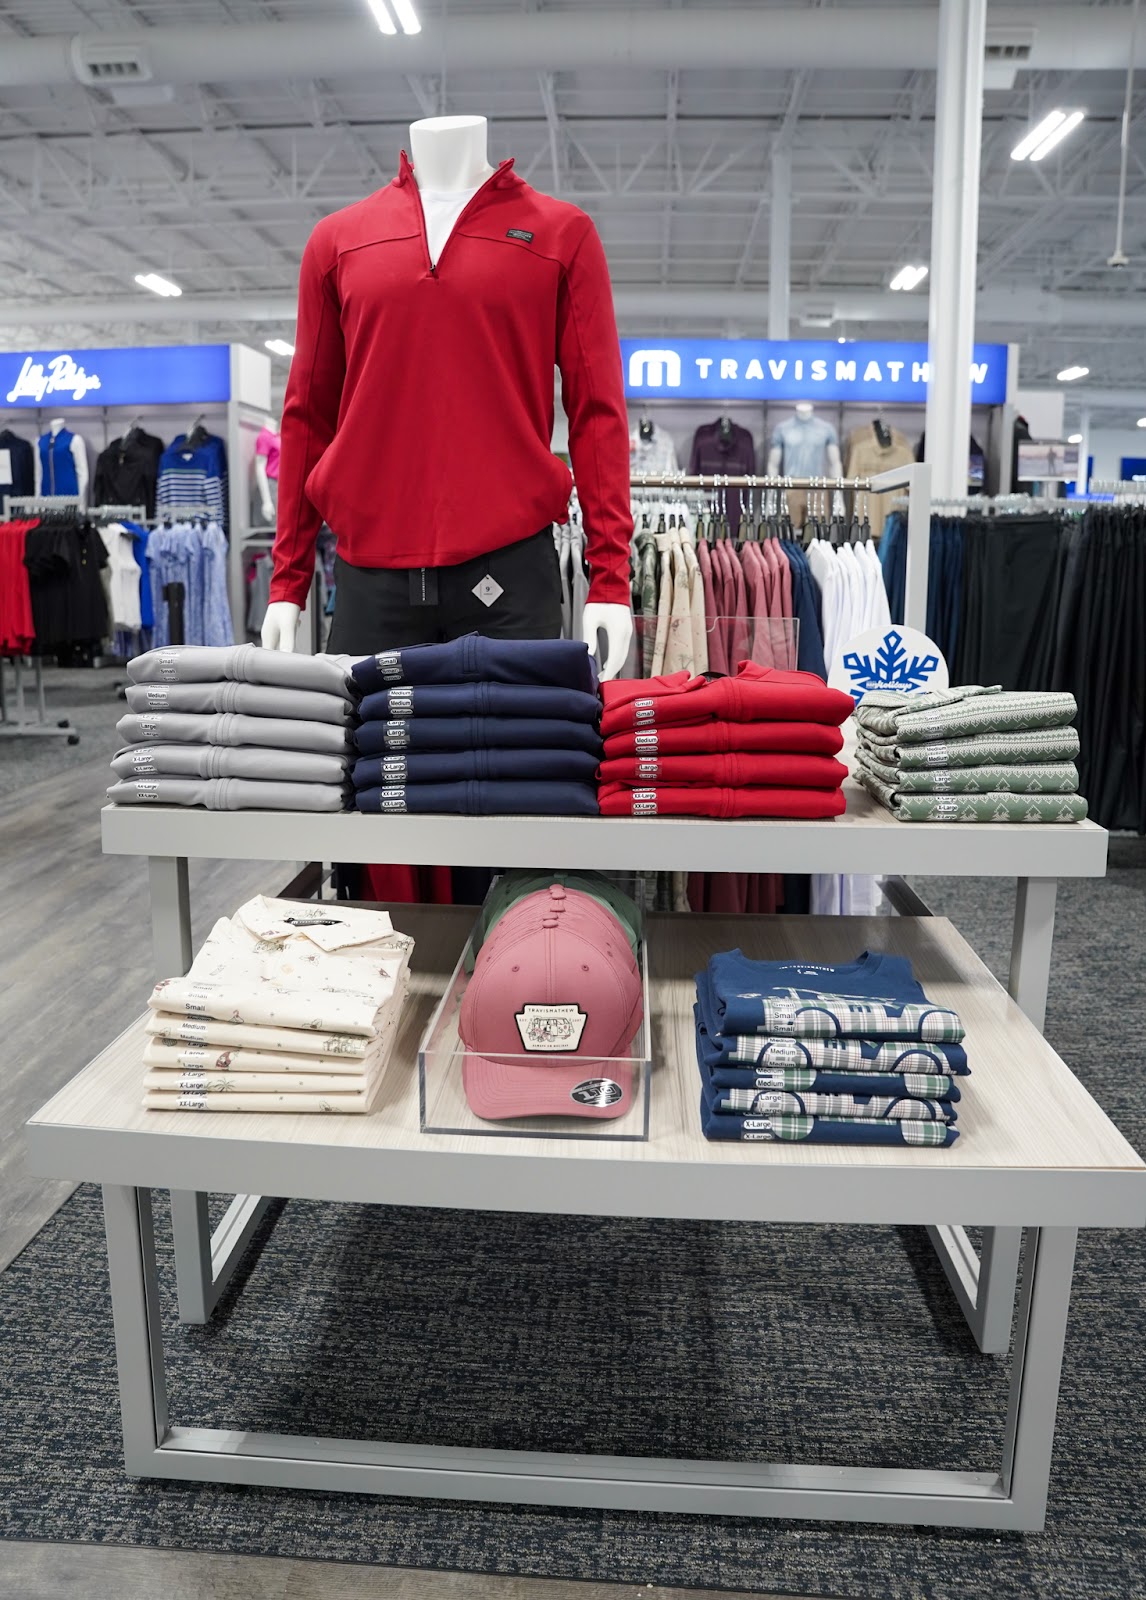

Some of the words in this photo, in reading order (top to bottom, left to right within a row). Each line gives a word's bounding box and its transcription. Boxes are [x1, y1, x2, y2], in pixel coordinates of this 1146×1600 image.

[695, 358, 988, 384] TRAVISMATHW
[185, 1003, 206, 1011] Small
[774, 1011, 796, 1019] Small
[182, 1022, 206, 1030] Medium
[180, 1101, 205, 1109] XX-Large
[745, 1121, 771, 1129] X-Large
